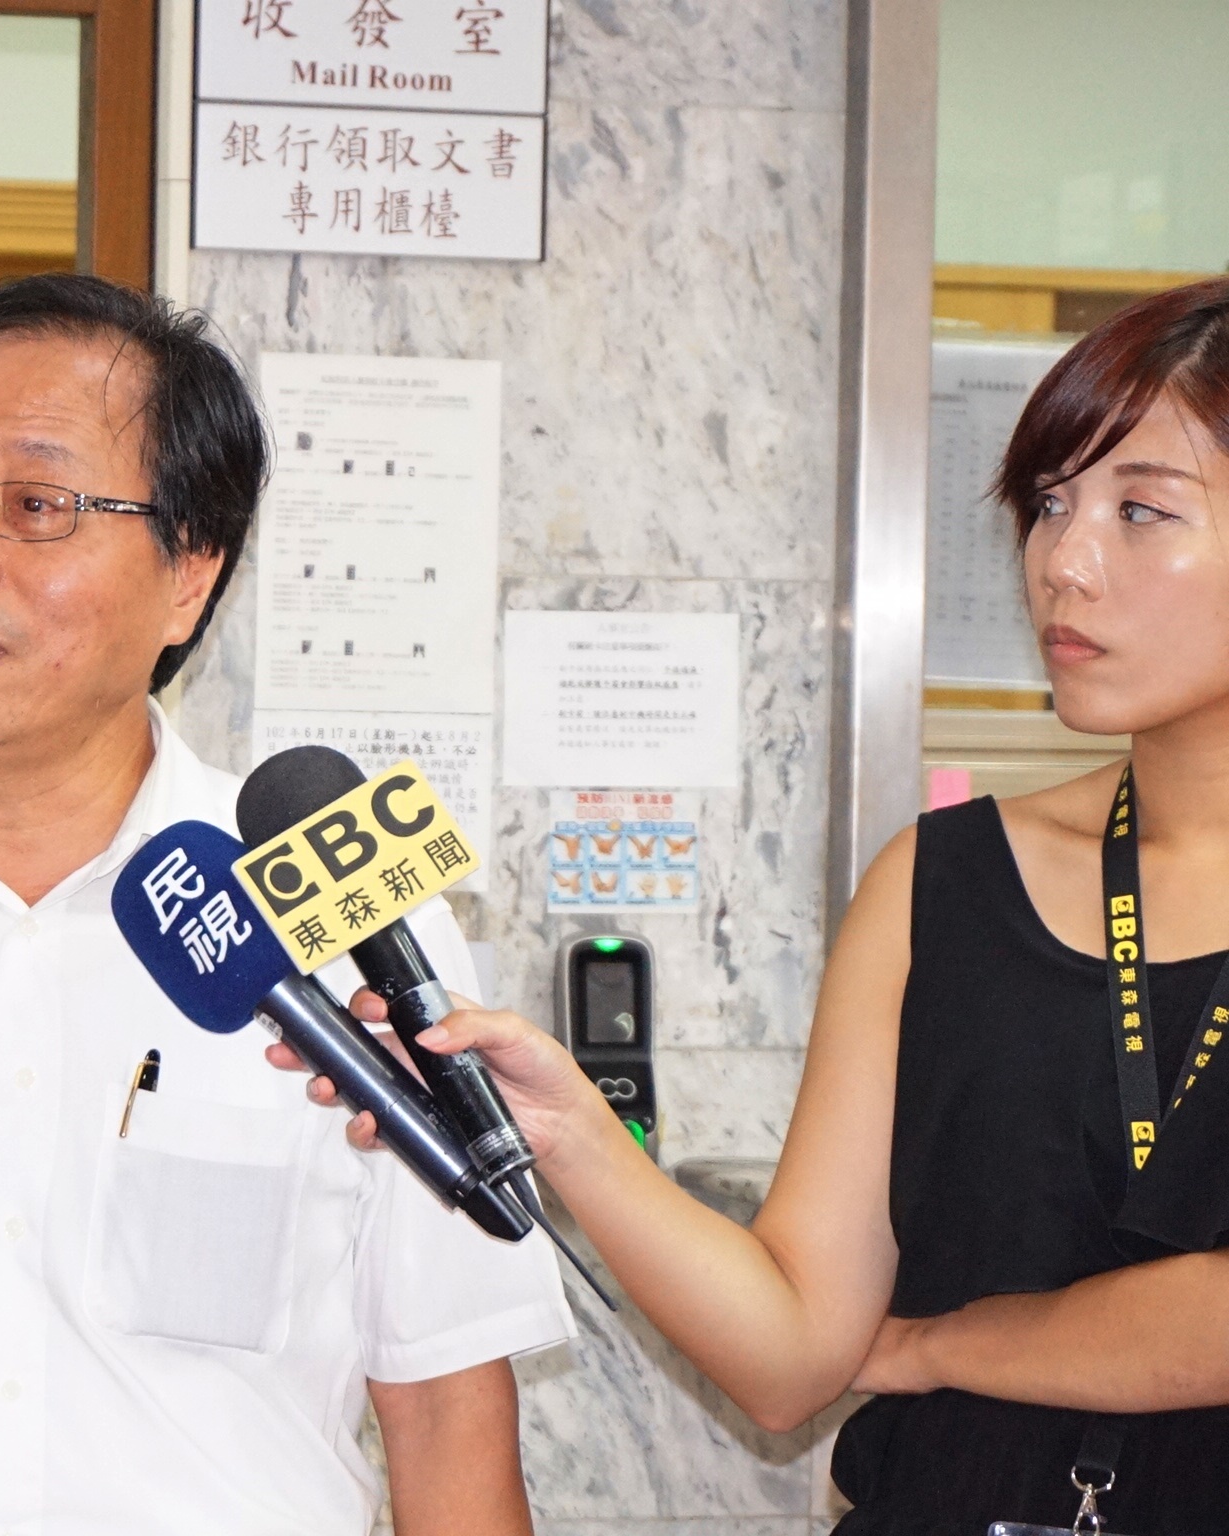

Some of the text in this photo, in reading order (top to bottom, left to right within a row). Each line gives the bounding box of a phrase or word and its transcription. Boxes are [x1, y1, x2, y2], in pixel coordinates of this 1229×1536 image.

[241, 0, 505, 55] 收發室
[291, 60, 454, 92] Mail Room
[221, 120, 523, 181] 銀行領取文書
[282, 180, 461, 239] 專用櫃檯
[243, 774, 435, 918] EBC
[142, 847, 253, 974] 民視
[289, 830, 471, 960] 東森新聞
[1118, 968, 1143, 1052] 東森電視
